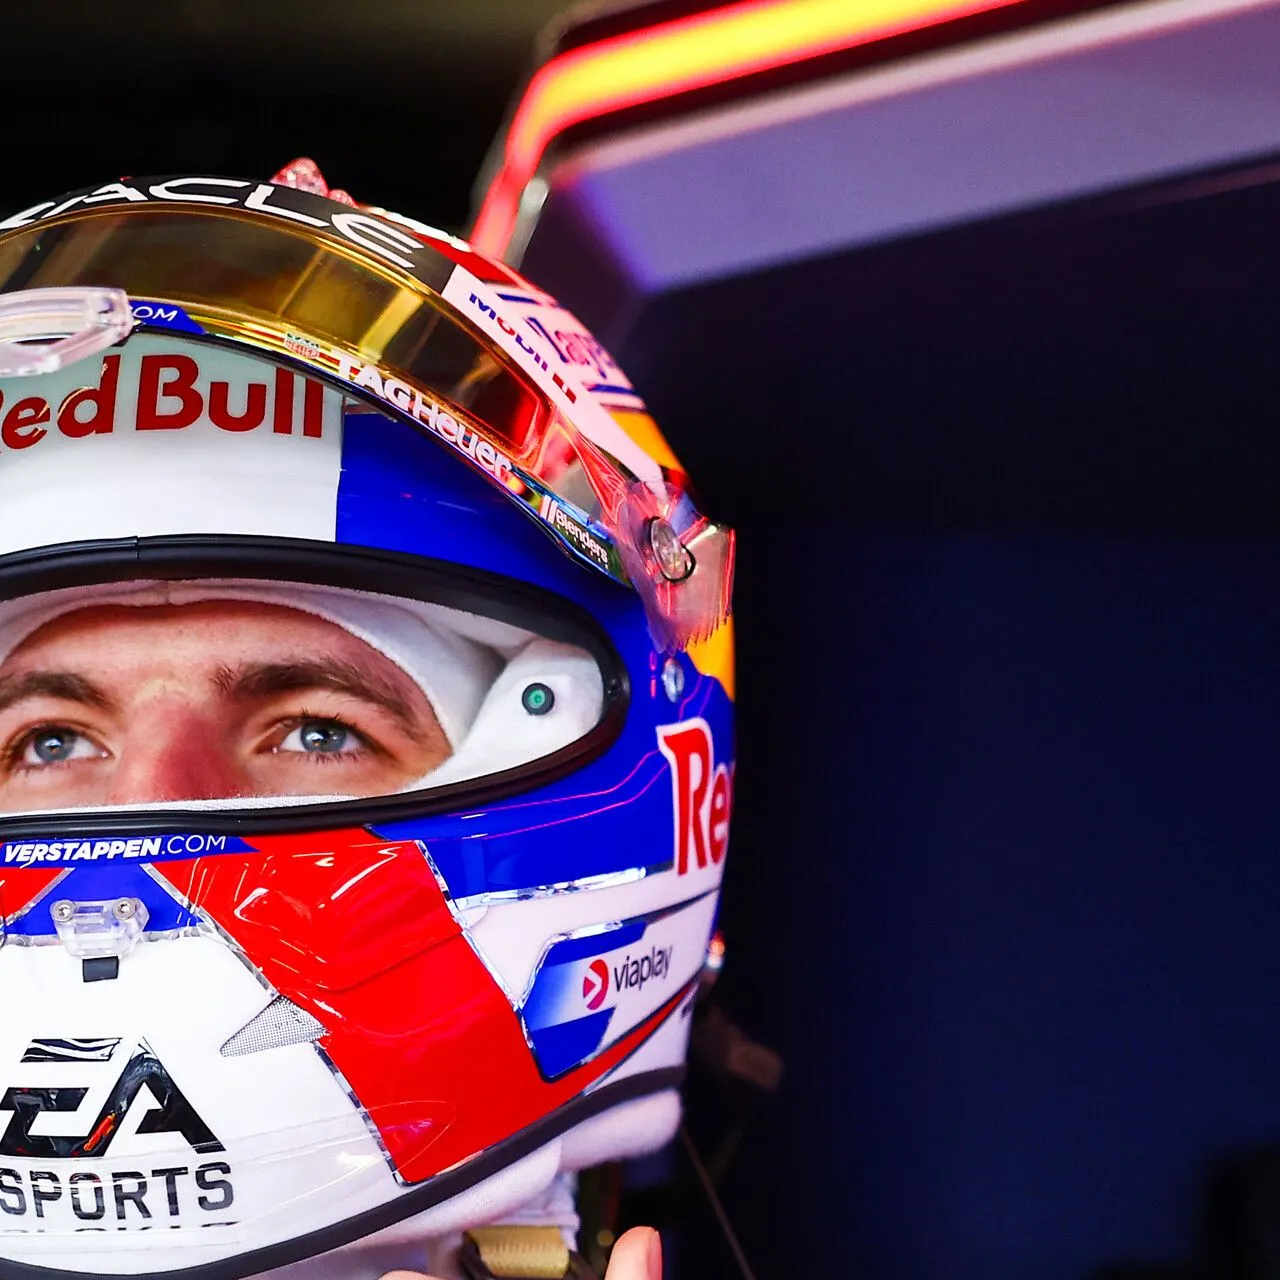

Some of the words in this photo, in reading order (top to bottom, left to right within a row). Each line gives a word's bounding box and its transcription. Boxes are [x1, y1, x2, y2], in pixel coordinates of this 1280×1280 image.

[135, 354, 324, 439] Bull
[4, 834, 226, 864] VERSTAPPEN.COM
[613, 945, 672, 992] viaplay
